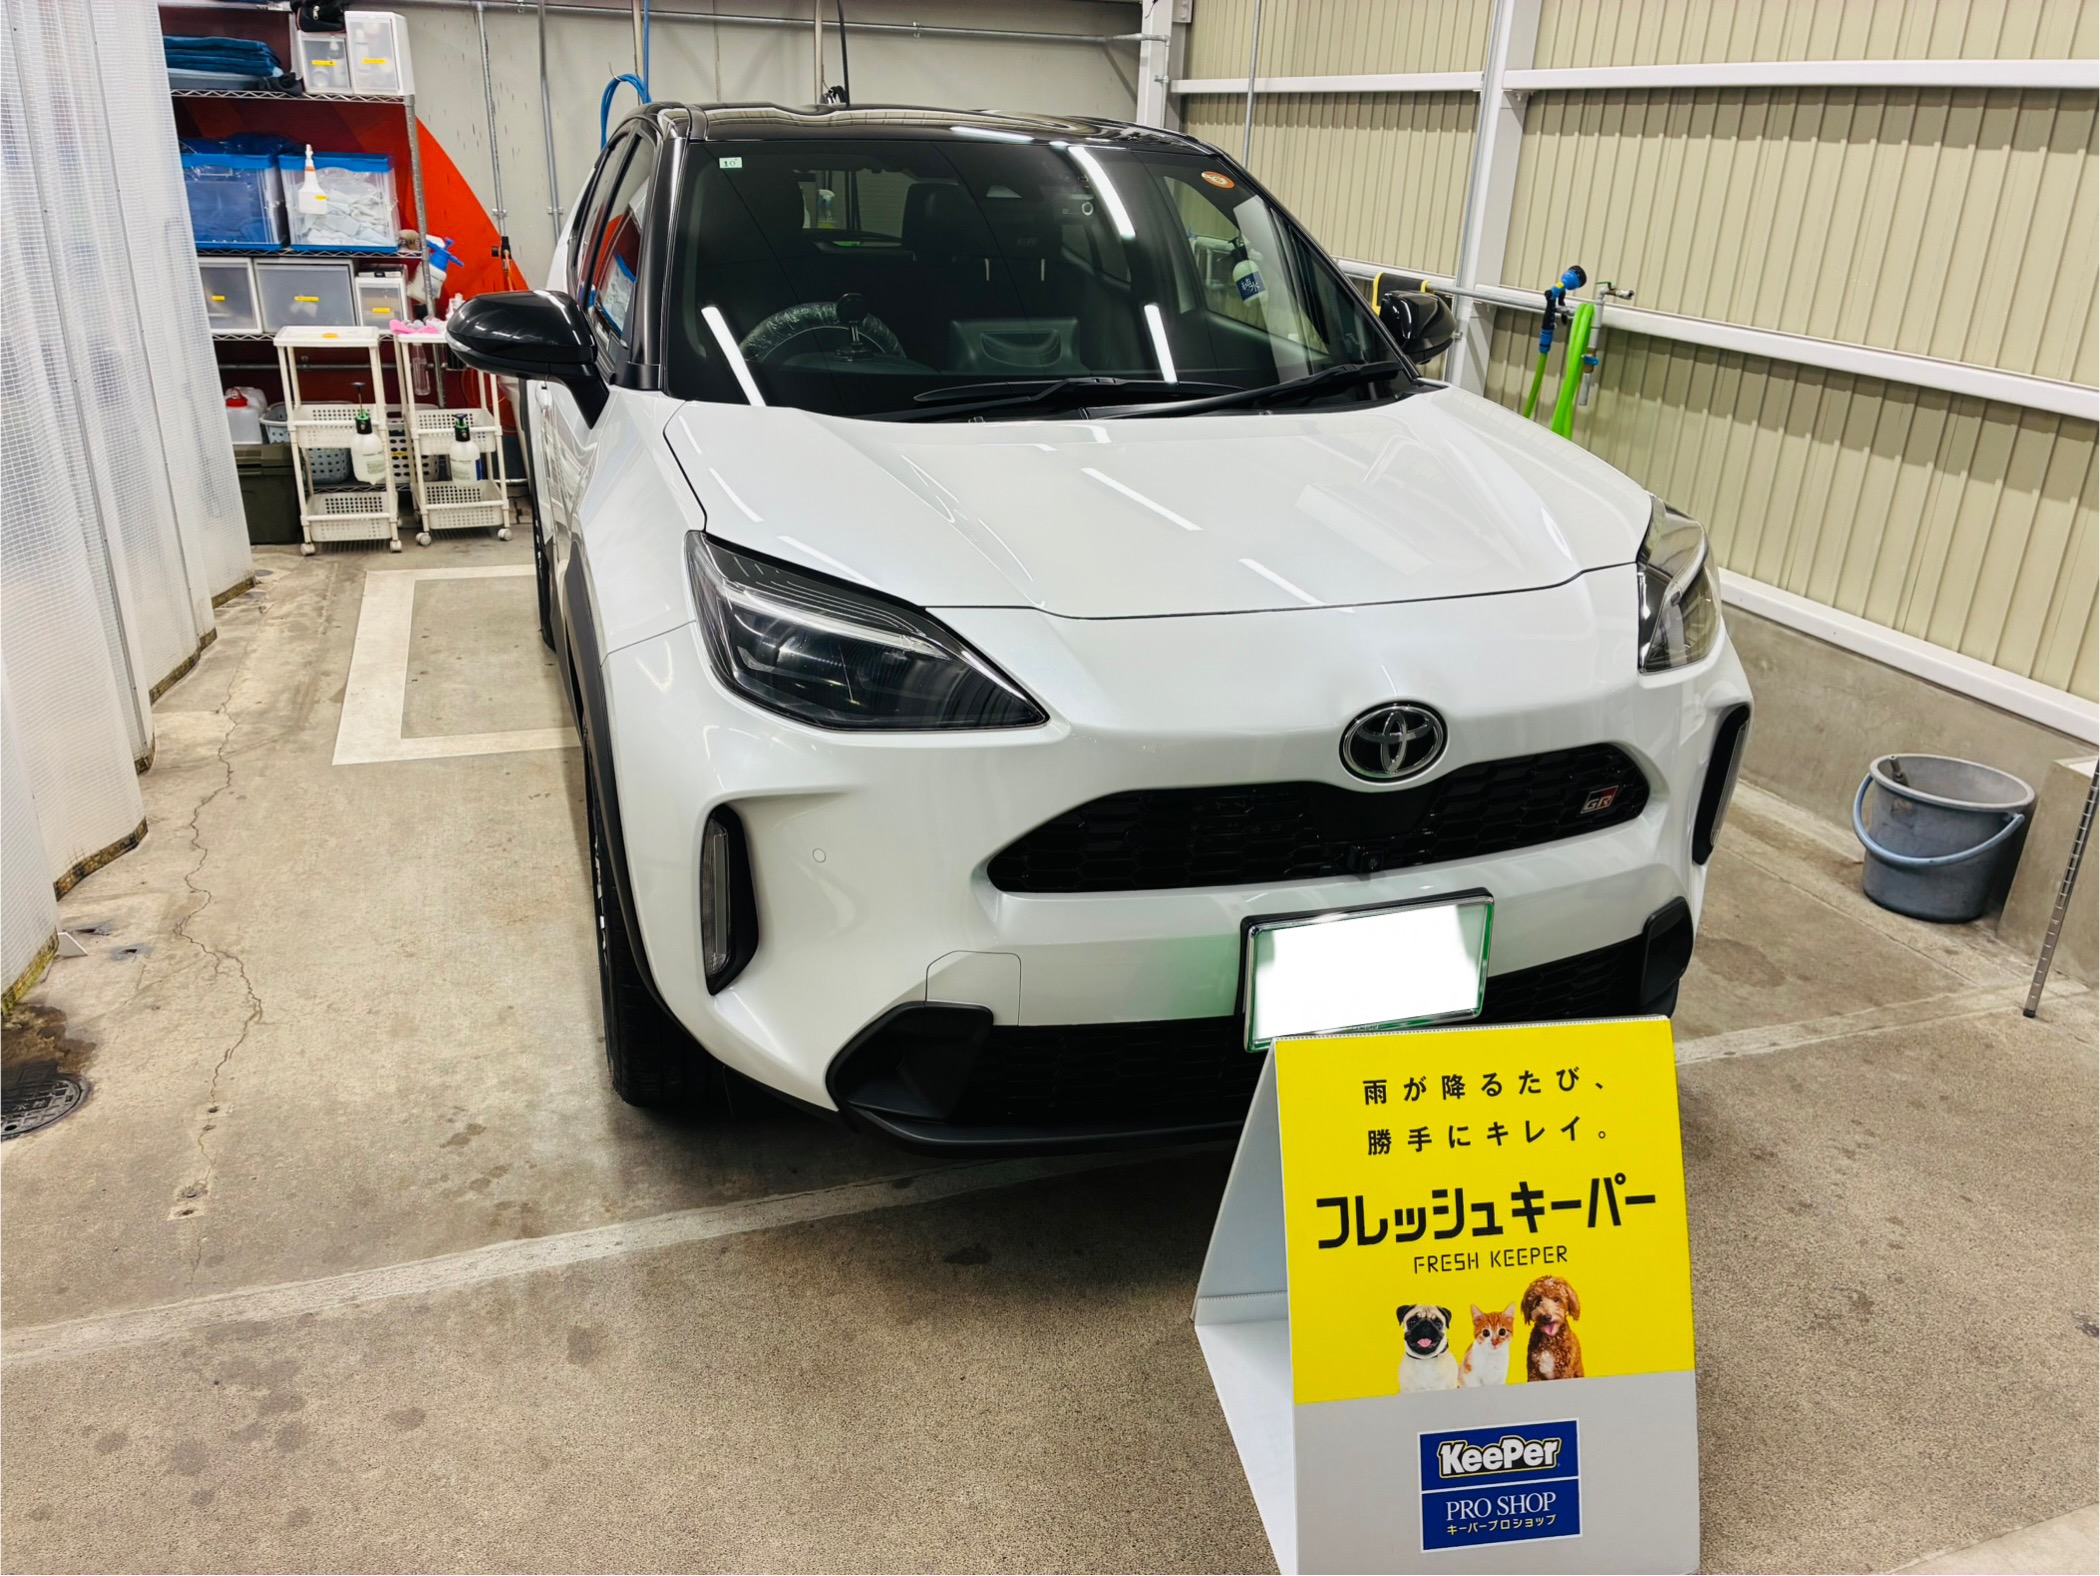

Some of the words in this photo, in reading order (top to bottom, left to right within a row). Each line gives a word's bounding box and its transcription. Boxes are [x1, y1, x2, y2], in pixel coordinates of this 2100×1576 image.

[1583, 795, 1613, 811] GR
[1362, 1066, 1604, 1106] 雨が降るたび、
[1367, 1116, 1606, 1156] 勝手にキレイ。
[1316, 1172, 1656, 1250] フレッシュキーパー
[1414, 1252, 1479, 1274] FRESH
[1490, 1245, 1568, 1268] KEEPER
[1439, 1437, 1560, 1476] KeePer
[1446, 1497, 1492, 1521] PRO
[1497, 1491, 1556, 1516] SHOP
[1447, 1514, 1557, 1535] キーパープロショップ
